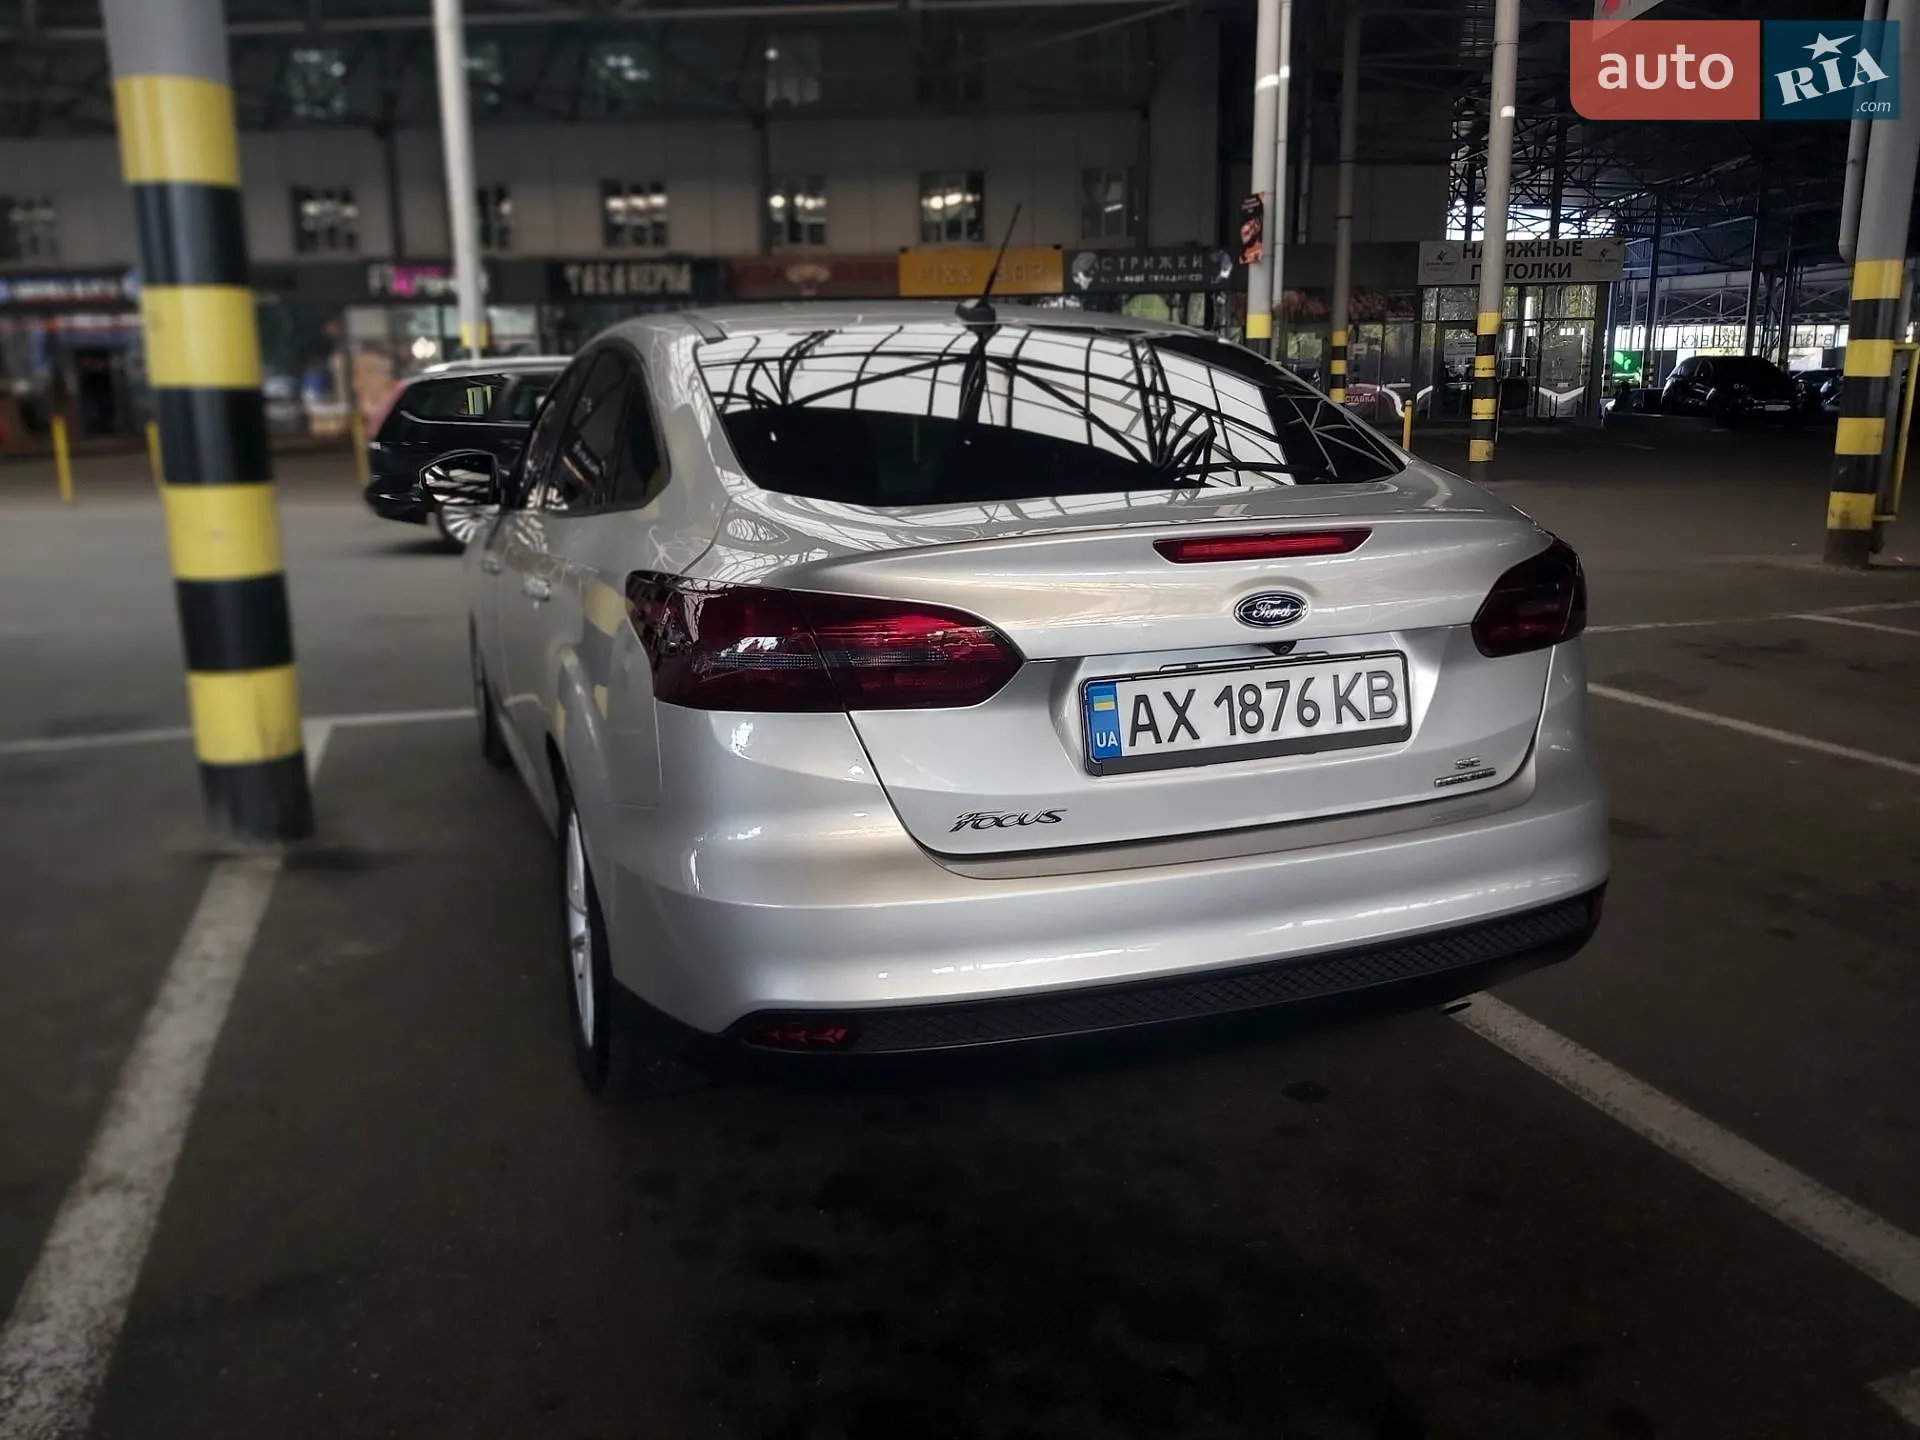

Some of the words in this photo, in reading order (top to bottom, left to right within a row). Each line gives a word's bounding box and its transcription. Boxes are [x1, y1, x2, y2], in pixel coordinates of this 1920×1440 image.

[1463, 241, 1584, 259] НЯЖНЫЕ
[1102, 255, 1203, 271] СТРИЖКИ
[1471, 263, 1572, 281] ПТОЛКИ
[1252, 600, 1292, 618] Ford
[1128, 688, 1200, 747] AX
[1213, 677, 1321, 736] 1876
[1333, 670, 1398, 724] KB
[1096, 730, 1118, 749] UA
